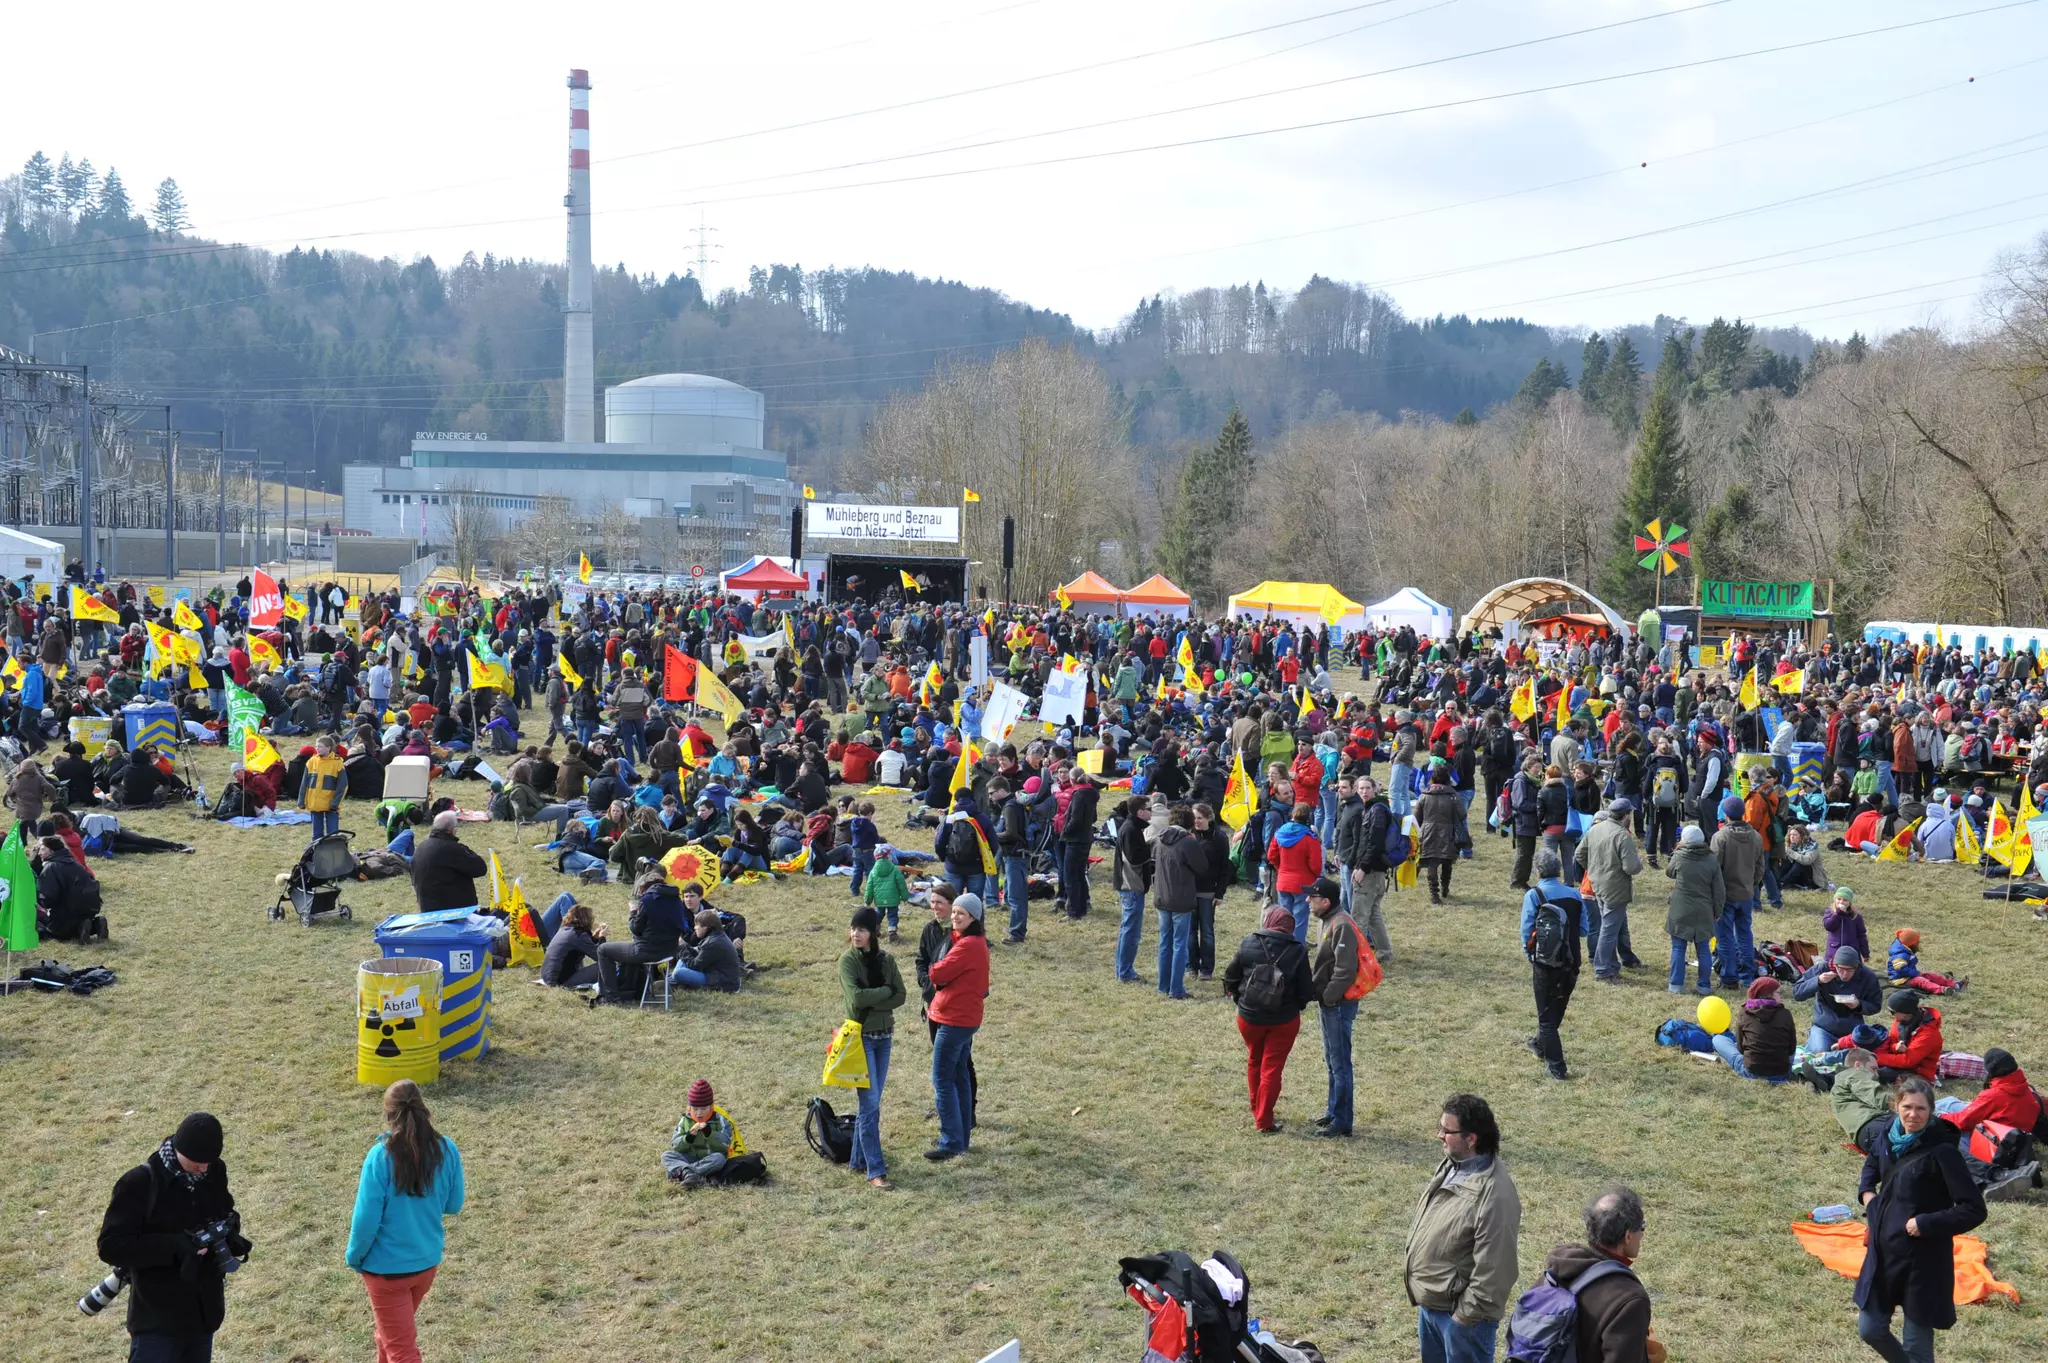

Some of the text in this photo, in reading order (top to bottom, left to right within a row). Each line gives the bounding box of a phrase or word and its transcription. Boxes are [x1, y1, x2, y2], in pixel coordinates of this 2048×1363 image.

[416, 431, 488, 440] BKW ENERGIE AG
[826, 507, 942, 526] Mühleberg und Beznau
[840, 526, 862, 537] vom
[865, 525, 888, 538] Netz
[899, 526, 926, 539] Jetzt!
[1771, 608, 1812, 617] ZUERICH
[383, 997, 419, 1012] Abfall
